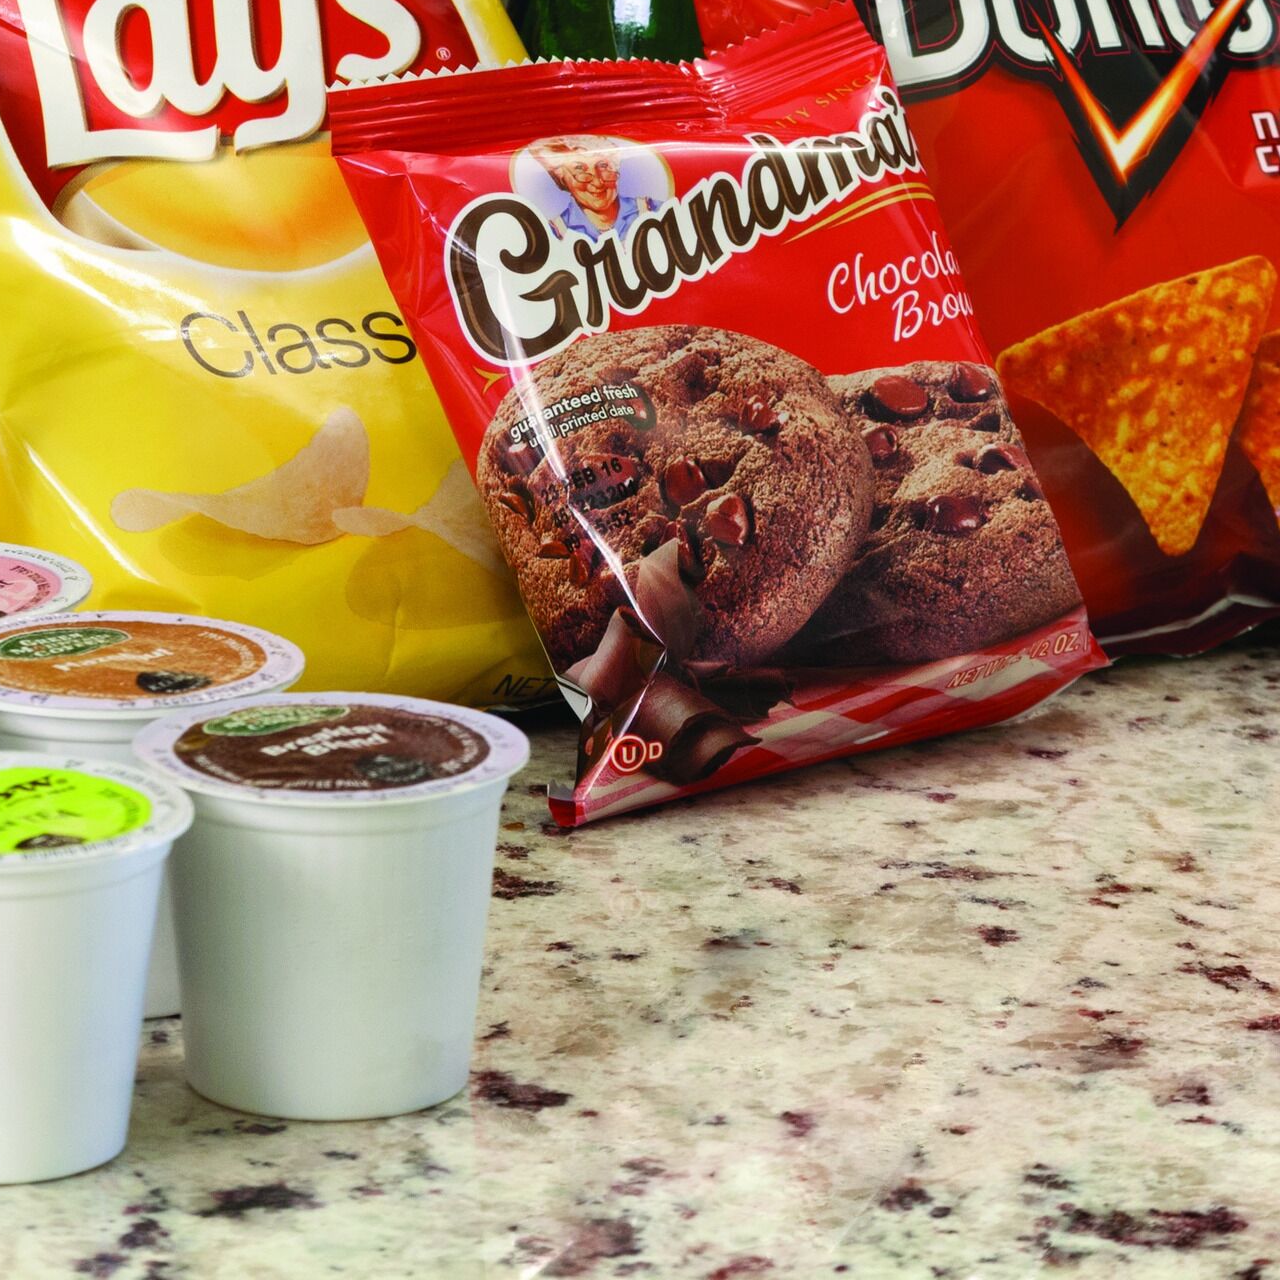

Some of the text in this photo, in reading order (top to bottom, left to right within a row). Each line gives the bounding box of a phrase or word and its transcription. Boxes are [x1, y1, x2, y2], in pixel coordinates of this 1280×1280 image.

[602, 382, 639, 401] fresh
[558, 404, 608, 438] printed
[609, 403, 636, 419] date
[946, 663, 985, 689] NET
